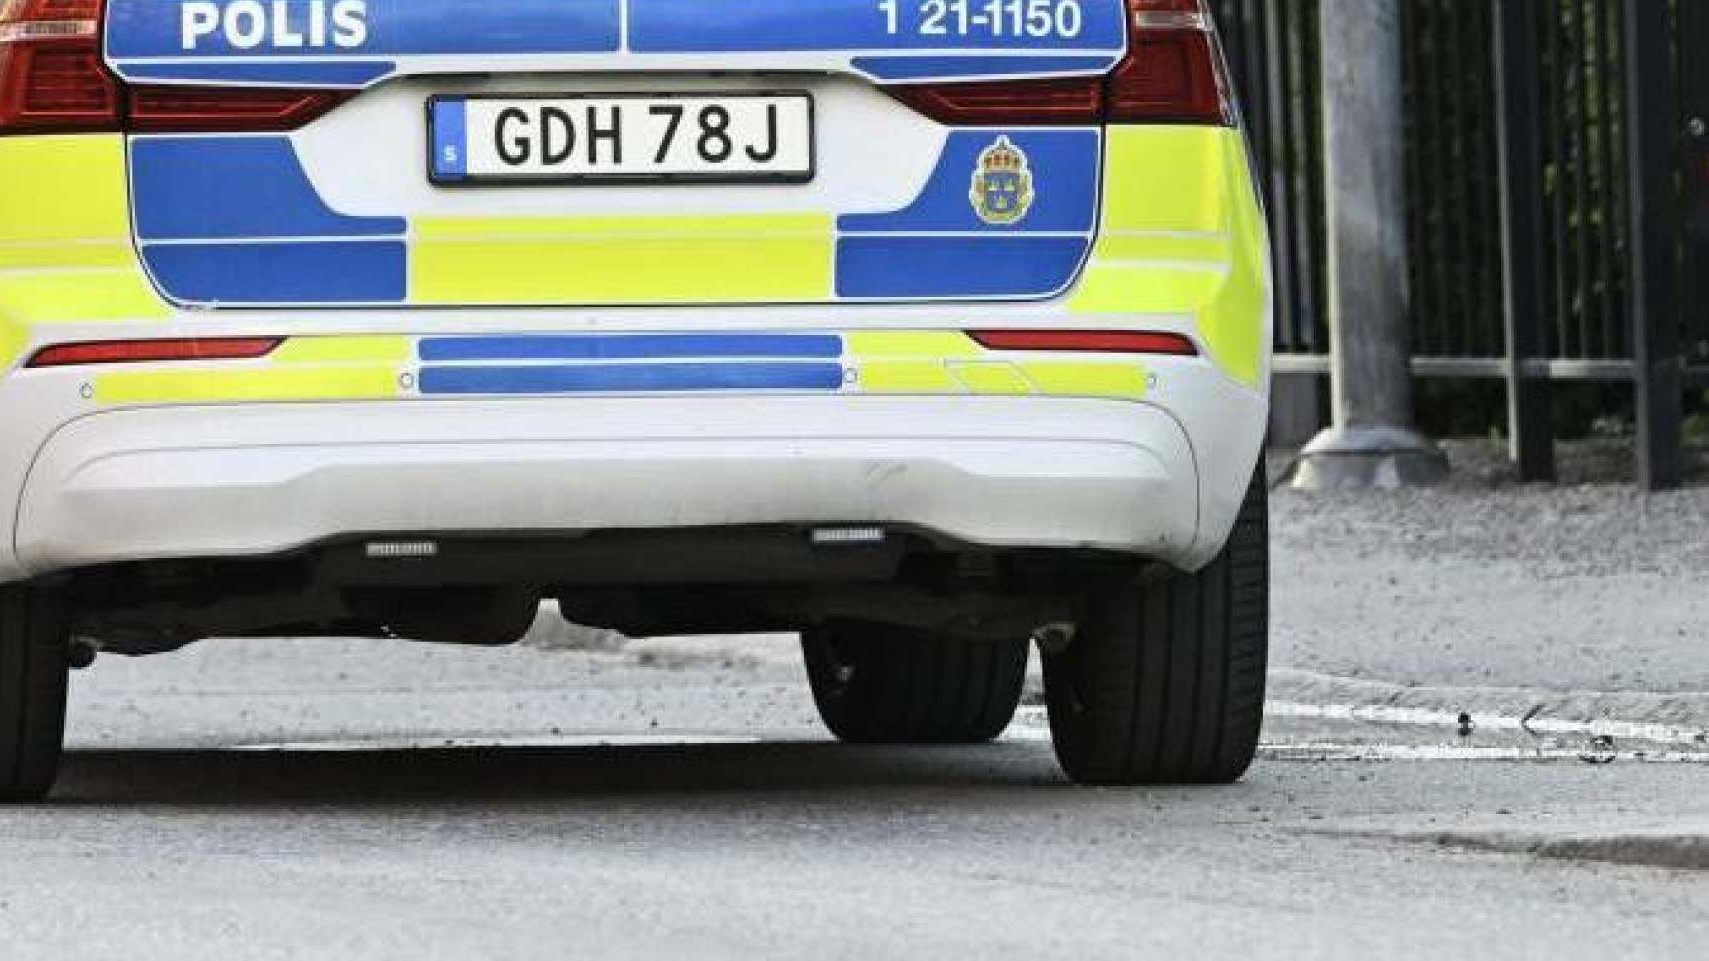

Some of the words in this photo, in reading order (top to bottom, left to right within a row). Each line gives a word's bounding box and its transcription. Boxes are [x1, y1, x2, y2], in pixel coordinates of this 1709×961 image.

[443, 145, 457, 162] S
[494, 104, 623, 166] GDH
[647, 103, 778, 164] 78J
